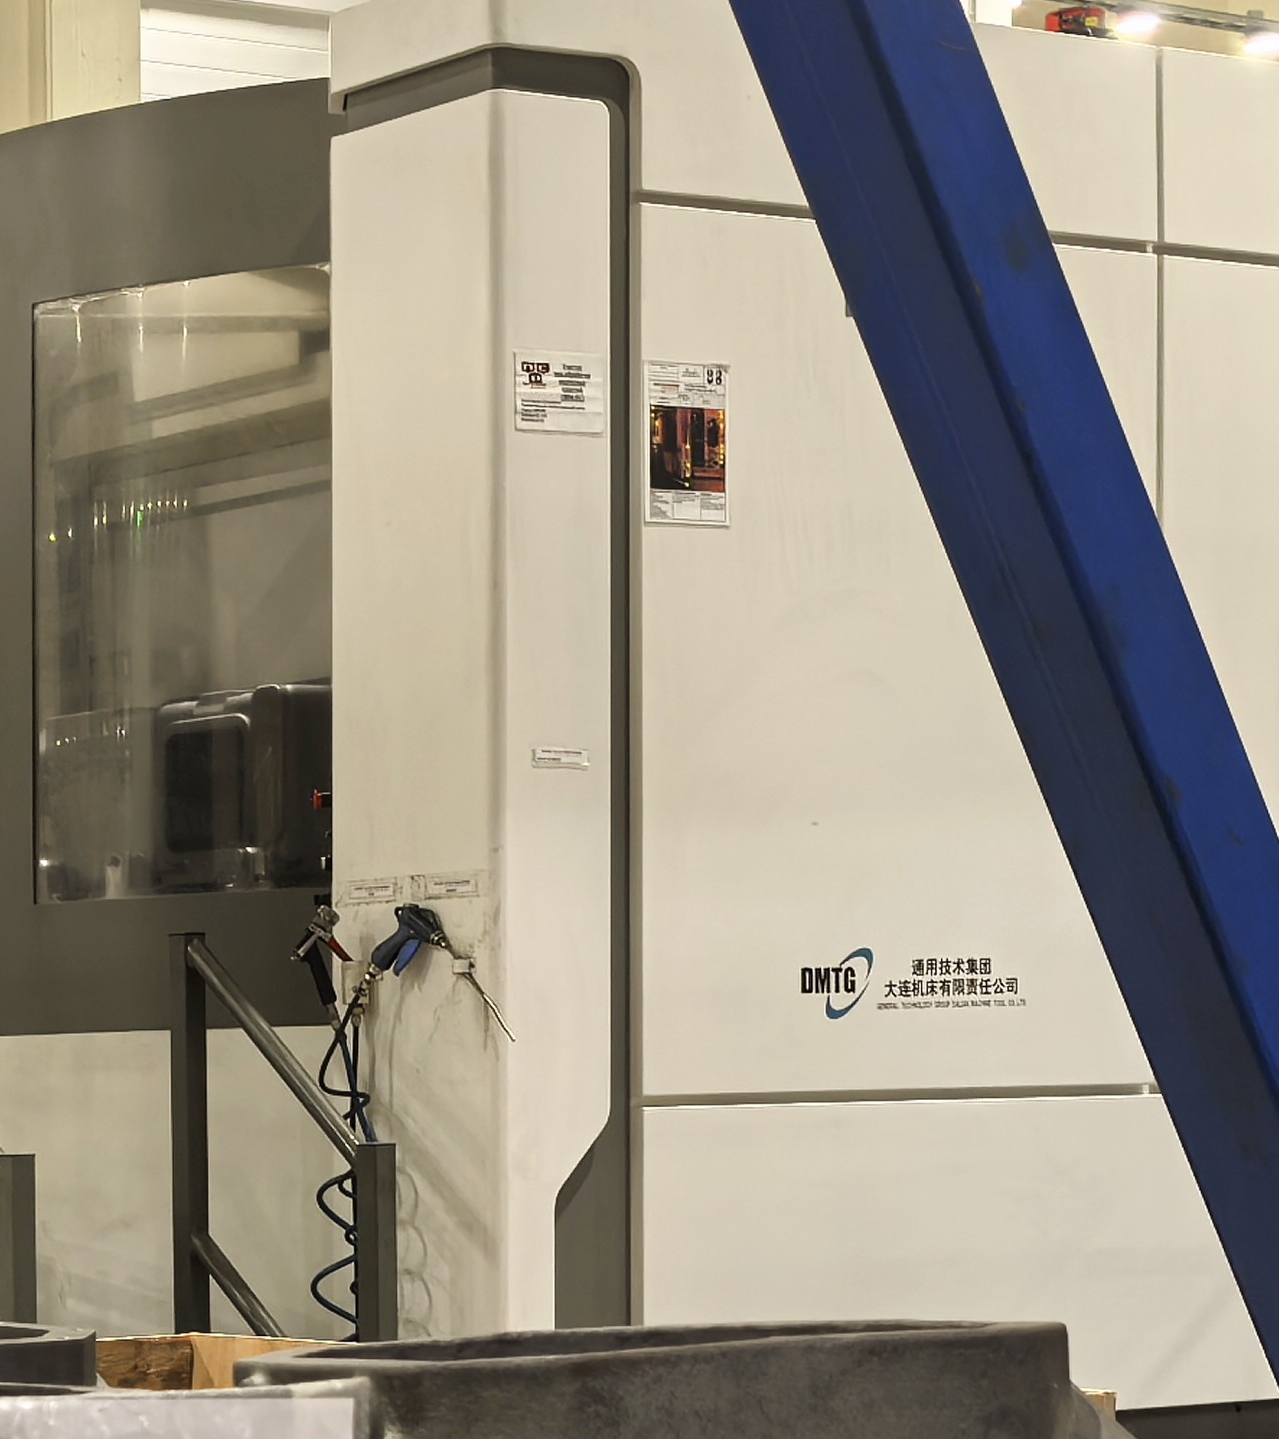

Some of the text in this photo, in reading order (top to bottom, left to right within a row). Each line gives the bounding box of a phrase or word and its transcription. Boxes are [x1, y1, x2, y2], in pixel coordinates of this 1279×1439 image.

[911, 958, 992, 976] 通用技术集团
[801, 966, 856, 994] DMTG
[884, 978, 1018, 997] 大连机床有限责任公司
